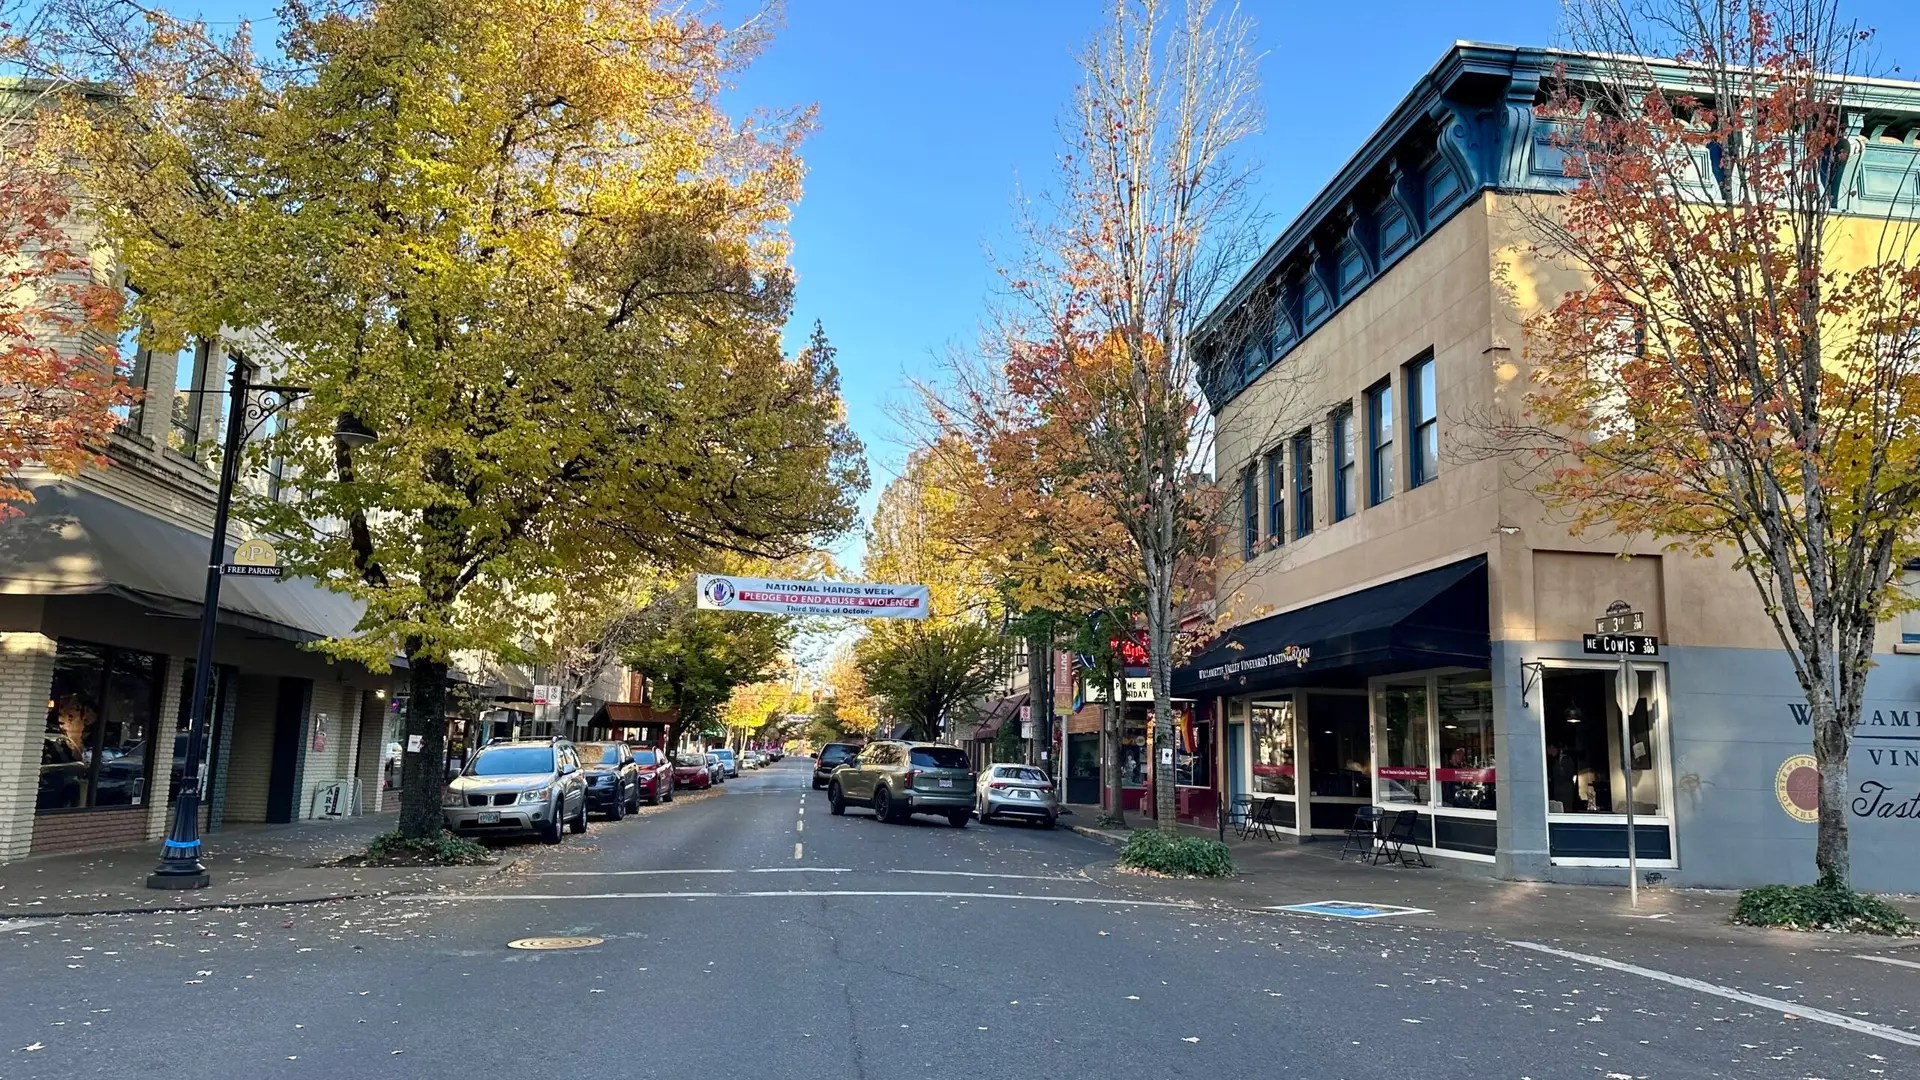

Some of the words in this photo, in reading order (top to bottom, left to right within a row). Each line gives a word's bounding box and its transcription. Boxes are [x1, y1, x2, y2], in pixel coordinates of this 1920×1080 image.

[249, 545, 264, 561] P
[227, 566, 247, 574] FREE
[247, 566, 280, 575] PARKING
[765, 583, 819, 593] NATIONAL
[823, 586, 861, 594] HANDS
[744, 592, 782, 602] PLEDGE
[785, 595, 798, 603] TO
[801, 596, 822, 604] END
[824, 597, 855, 605] ABUSE
[867, 598, 915, 607] VIOLENCE
[1598, 622, 1605, 633] NE
[1612, 617, 1625, 632] 3rd
[1634, 614, 1640, 622] St
[1587, 638, 1597, 650] NE
[1603, 636, 1636, 653] Cowls
[1644, 637, 1652, 646] St
[1642, 645, 1655, 654] 300
[1115, 682, 1136, 690] PME
[1125, 690, 1148, 698] RIDAY
